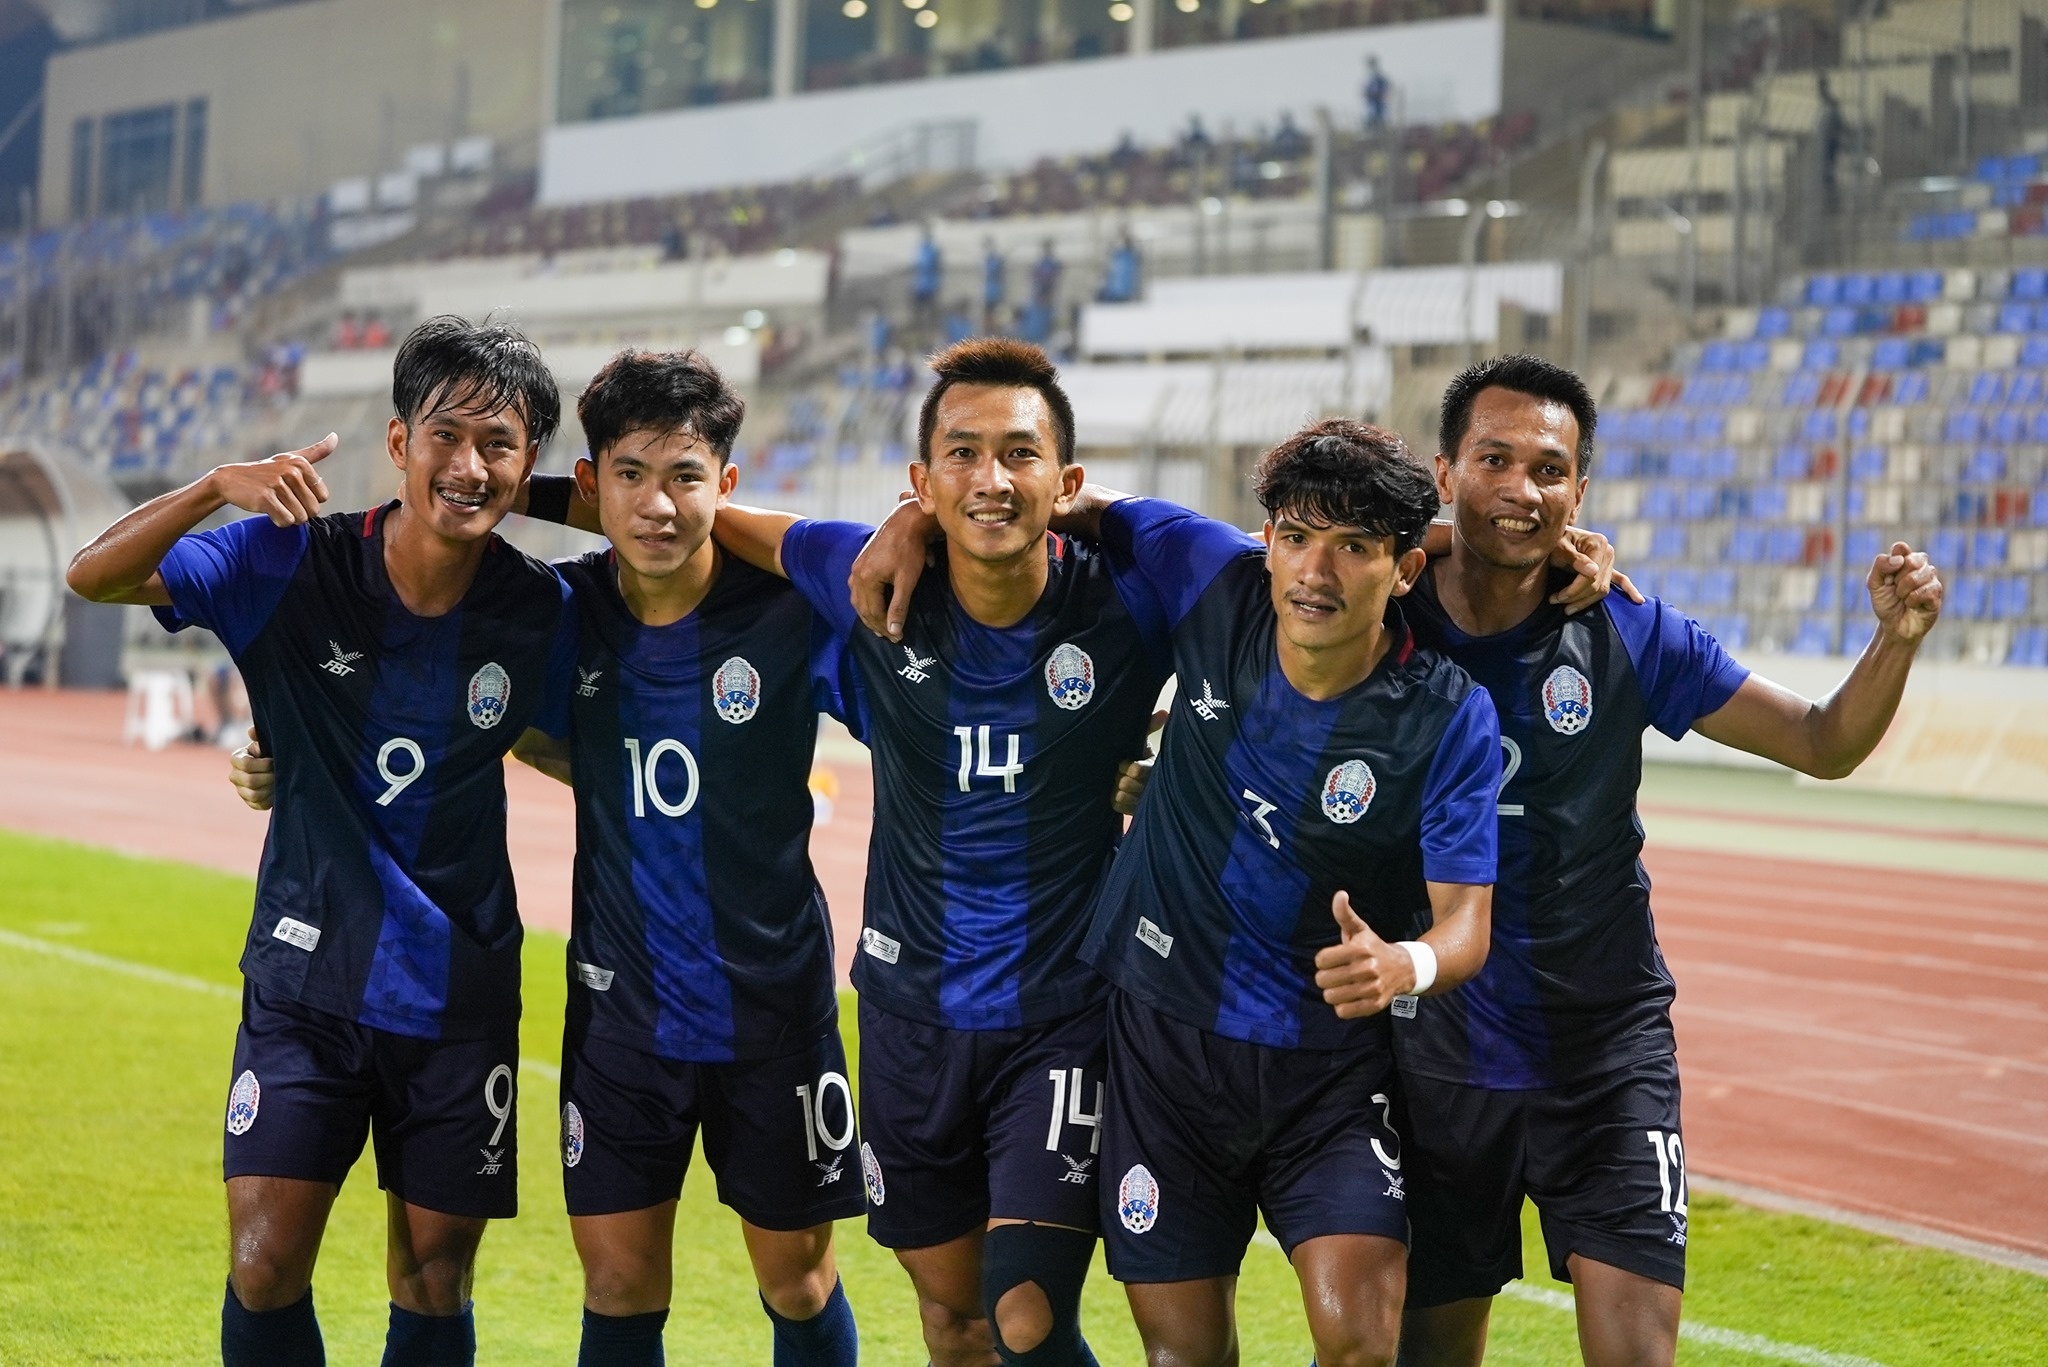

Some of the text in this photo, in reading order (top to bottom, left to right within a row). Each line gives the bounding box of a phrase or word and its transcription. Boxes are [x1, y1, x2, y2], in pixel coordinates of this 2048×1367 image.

[319, 660, 355, 677] FBT
[897, 665, 930, 684] FBT
[725, 687, 749, 703] FFC
[1060, 679, 1084, 691] FFC
[479, 699, 500, 709] FFC
[1190, 698, 1219, 721] FBT
[1556, 701, 1581, 714] FFC
[953, 725, 1024, 793] 14
[375, 737, 426, 807] 9
[624, 738, 700, 818] 10
[1496, 735, 1525, 816] 2
[1335, 793, 1359, 807] FFC
[1240, 788, 1280, 850] 3
[485, 1063, 513, 1146] 9
[1046, 1067, 1104, 1155] 14
[796, 1071, 855, 1162] 10
[1370, 1093, 1402, 1171] 3
[476, 1164, 503, 1175] FBT
[817, 1168, 844, 1188] FBT
[1058, 1171, 1091, 1185] FBT
[1646, 1131, 1688, 1217] 12
[1383, 1185, 1406, 1201] FBT
[1128, 1201, 1149, 1213] FFC
